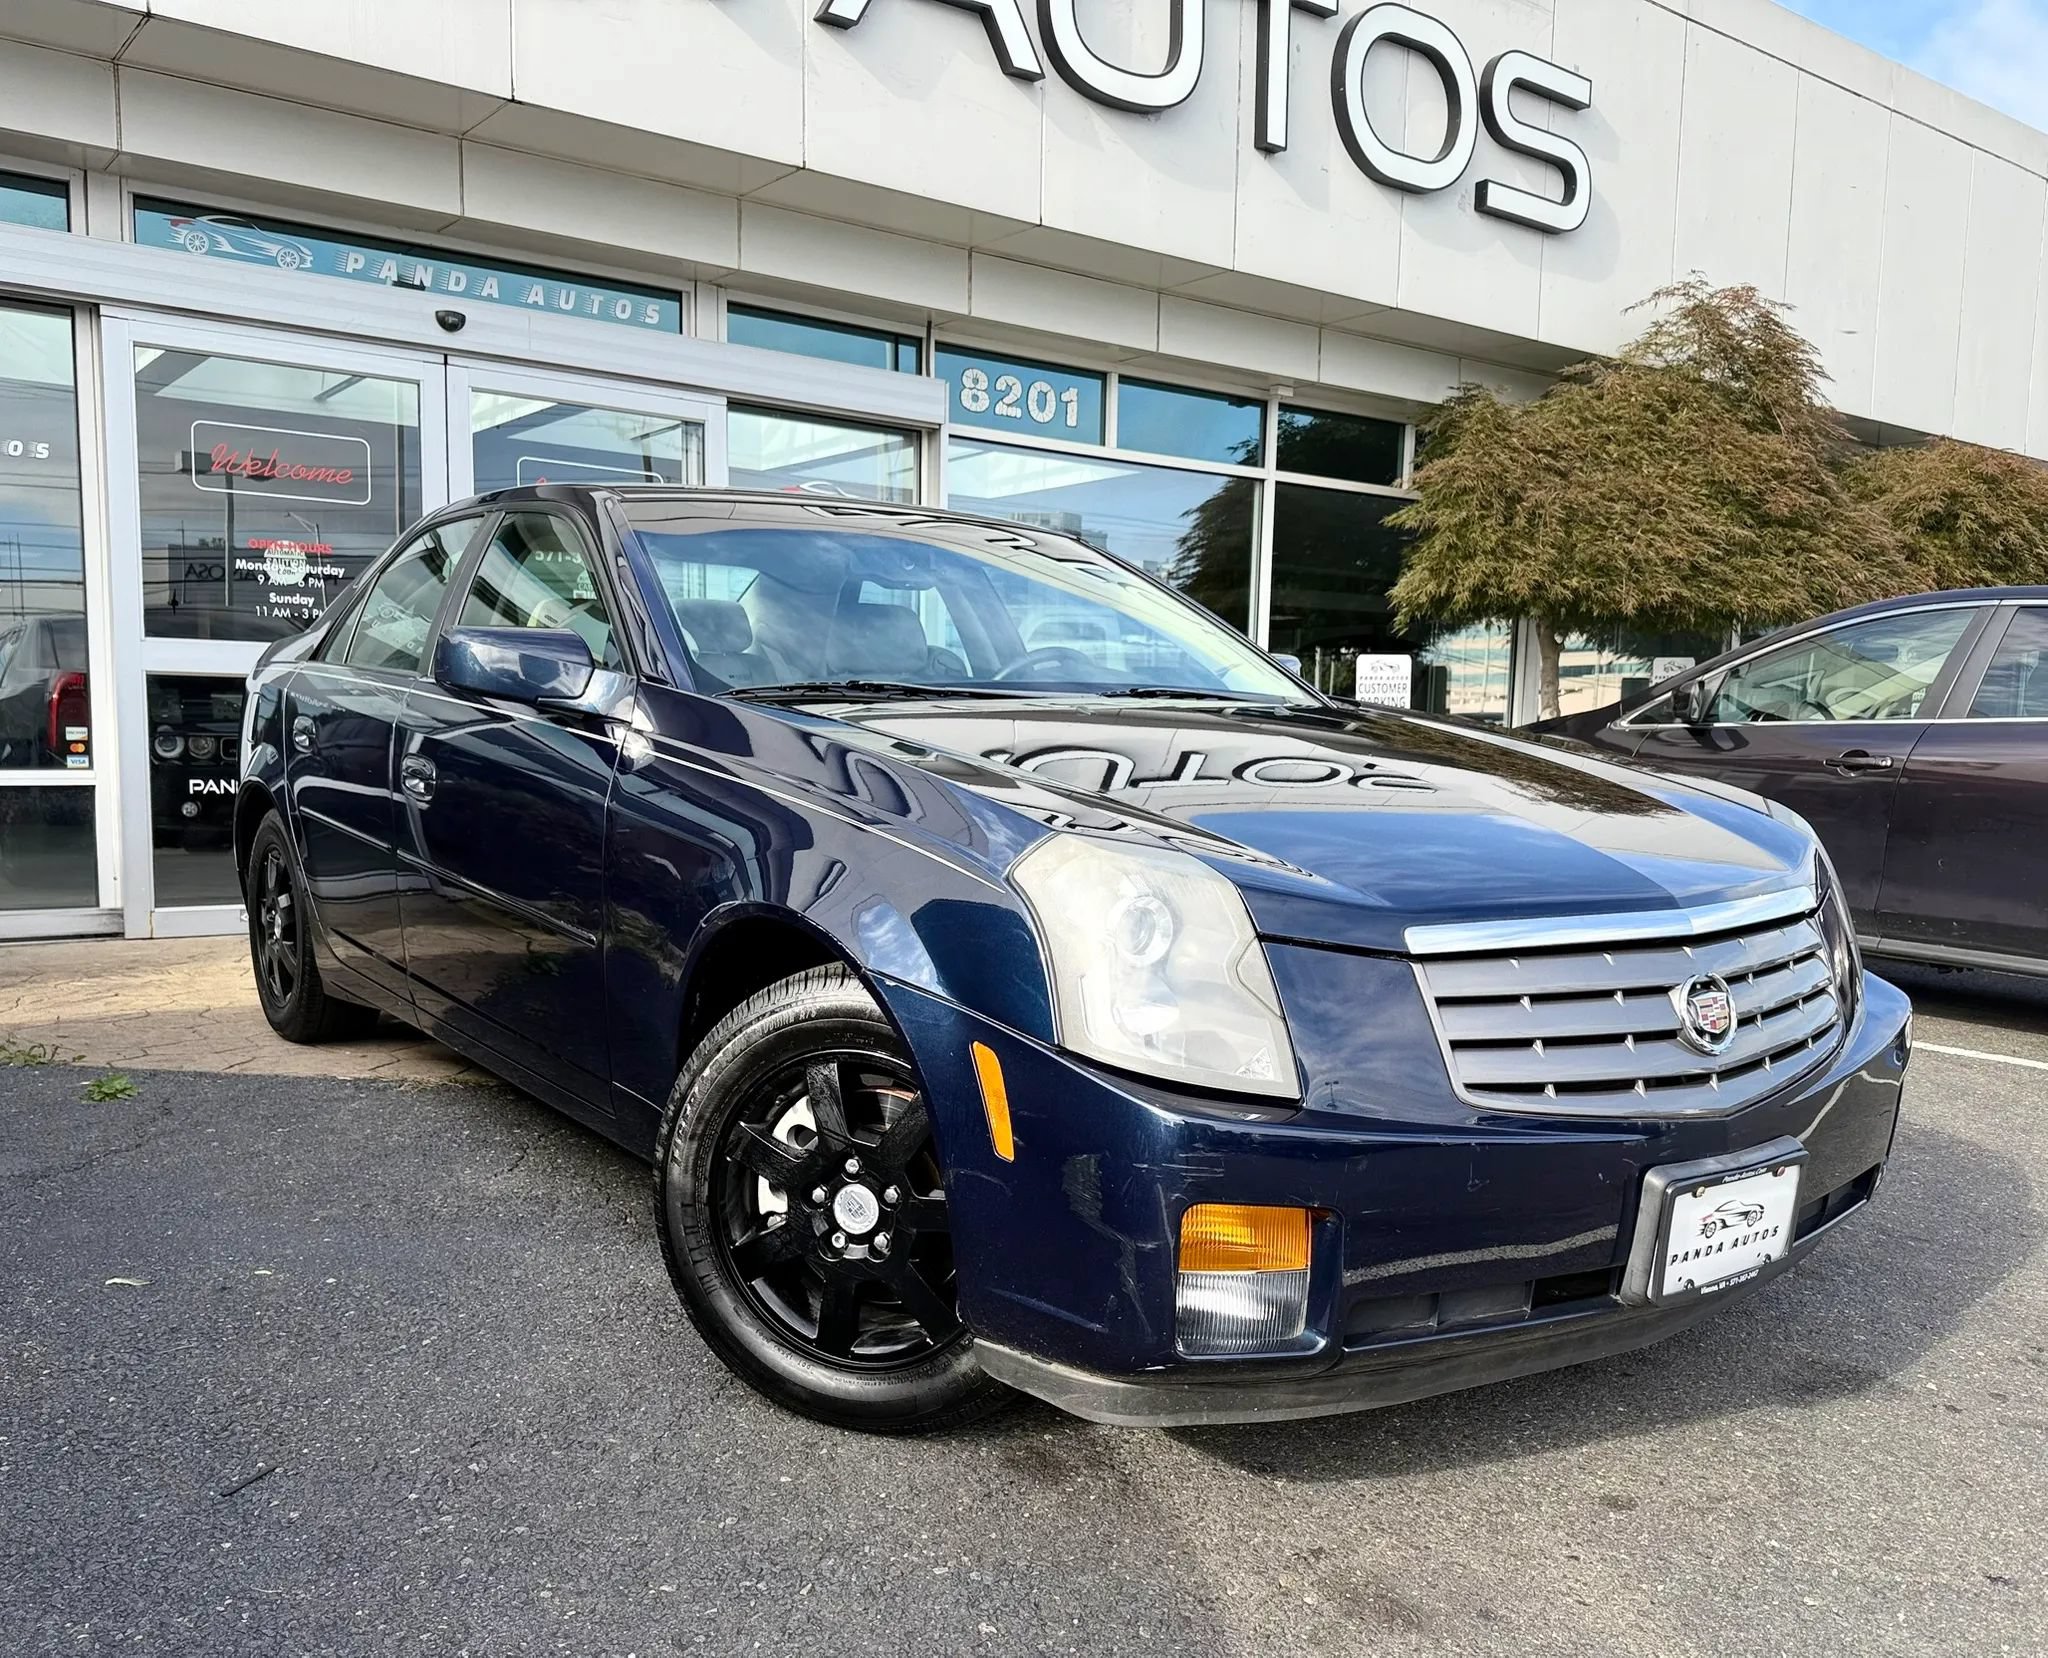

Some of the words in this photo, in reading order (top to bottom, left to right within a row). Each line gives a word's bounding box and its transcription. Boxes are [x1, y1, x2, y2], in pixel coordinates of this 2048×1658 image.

[341, 251, 500, 299] PANDA
[525, 284, 660, 325] AUTOS
[959, 367, 1079, 429] 8201
[210, 442, 354, 485] Welcome
[257, 574, 265, 586] 9
[268, 577, 287, 587] AM
[308, 577, 325, 589] PM
[269, 592, 315, 608] Sunday
[255, 605, 268, 617] 11
[272, 607, 291, 618] AM
[301, 608, 309, 619] 3
[1358, 682, 1408, 694] CUSTOMER
[188, 778, 239, 795] PAN
[1669, 1241, 1724, 1267] PANDA
[1731, 1225, 1780, 1249] AUTOS
